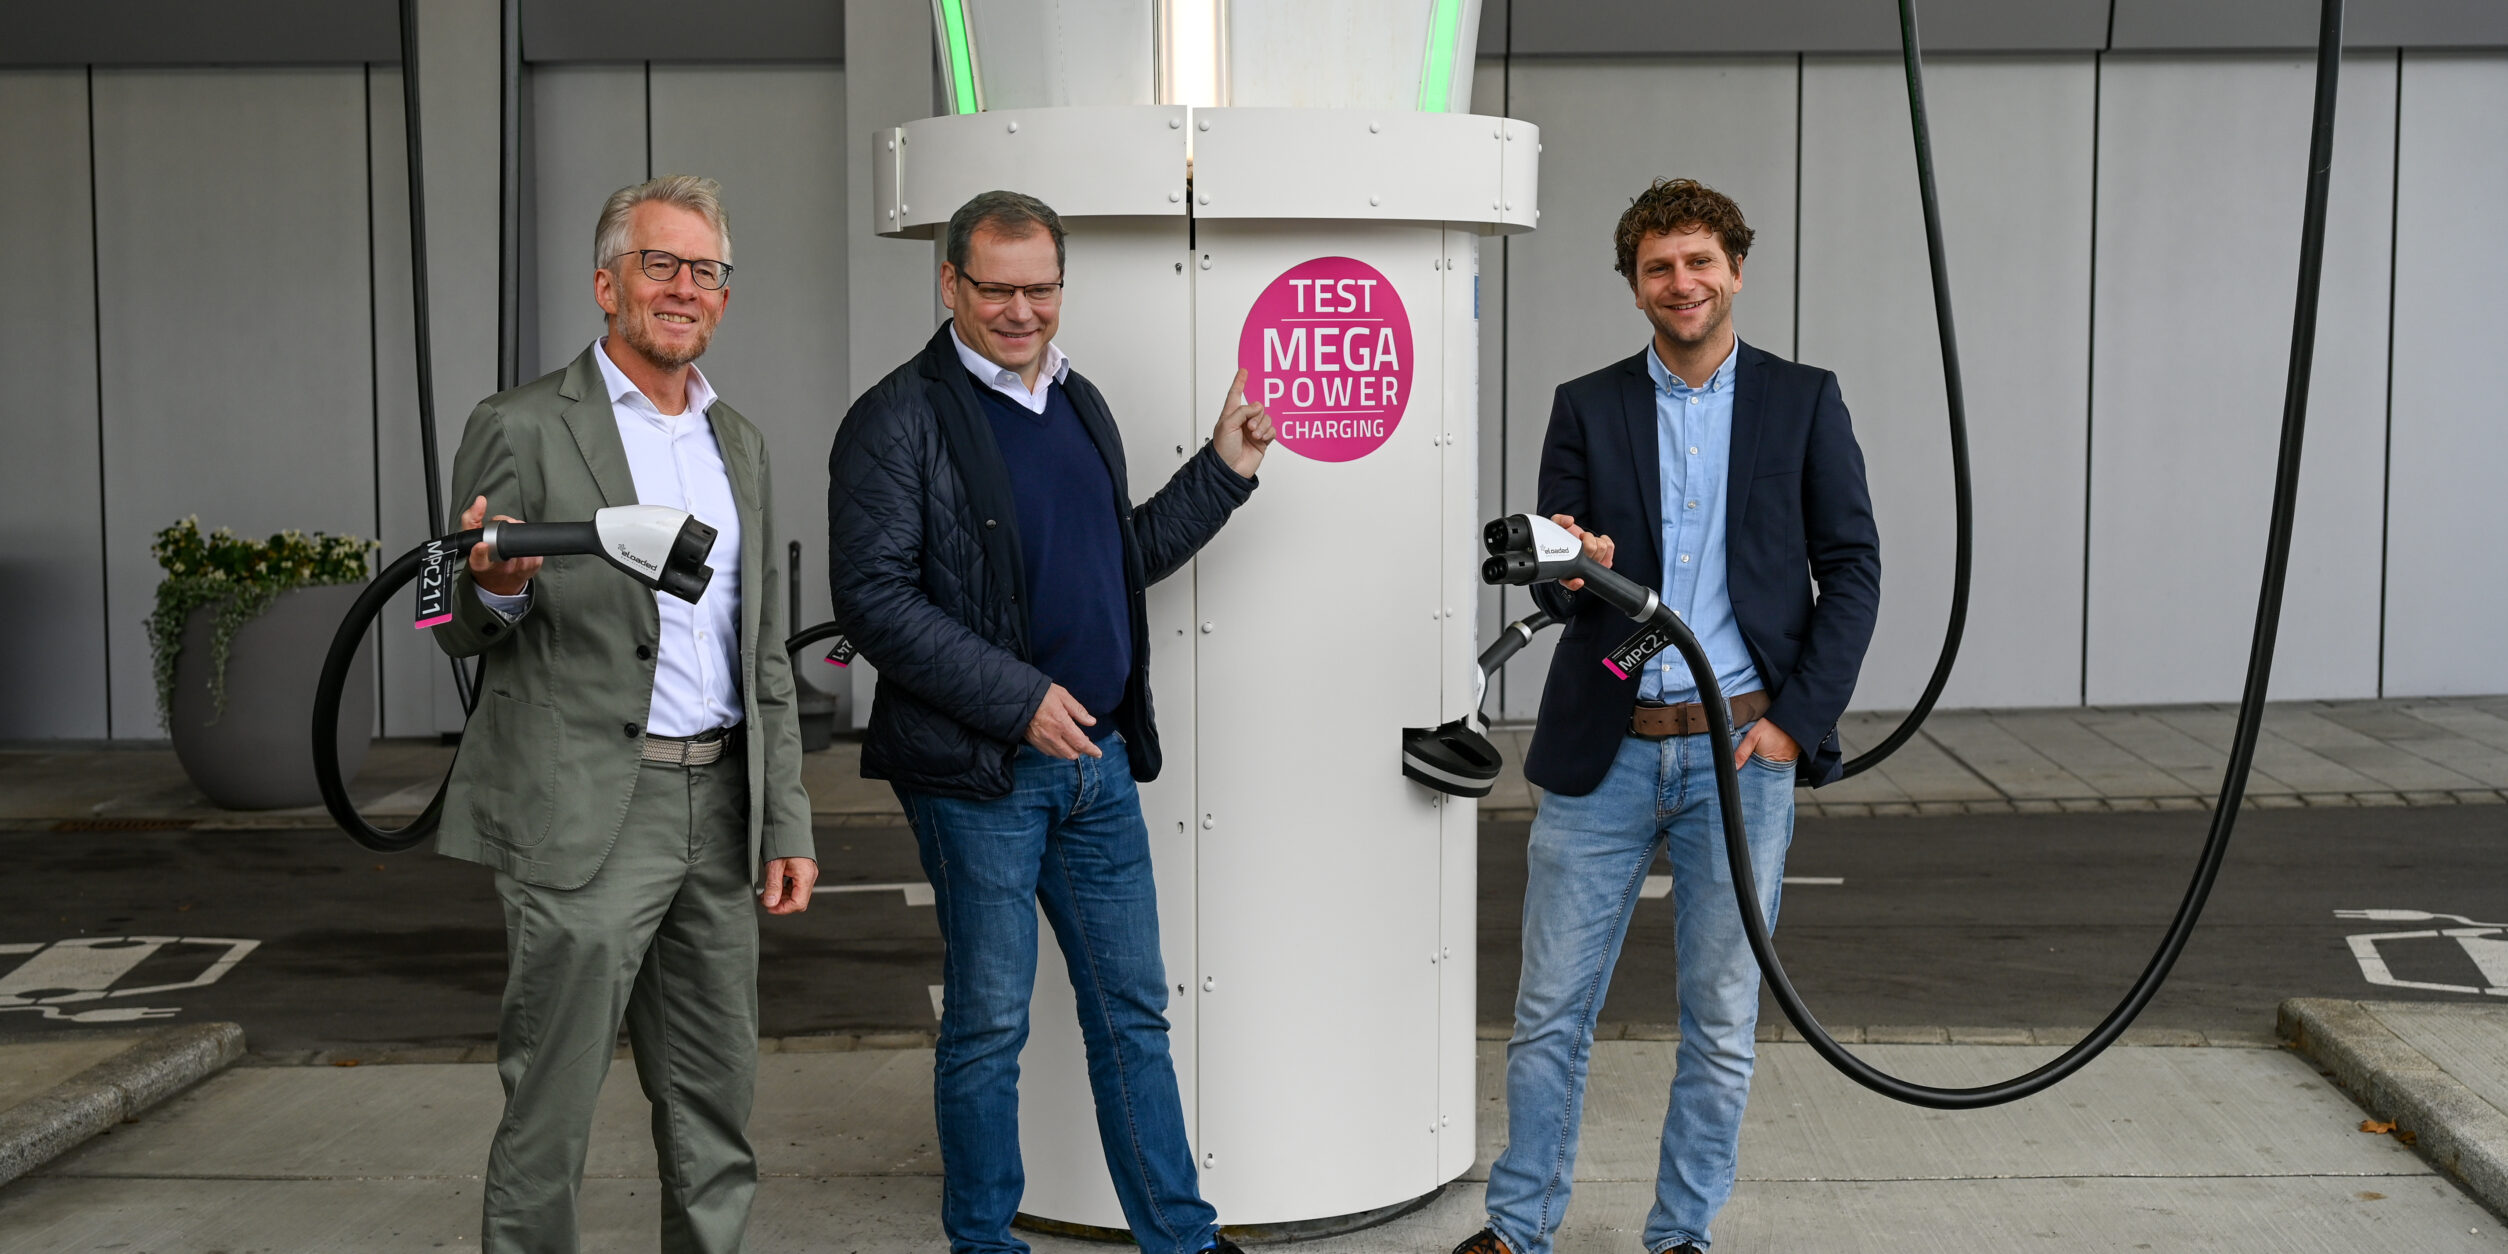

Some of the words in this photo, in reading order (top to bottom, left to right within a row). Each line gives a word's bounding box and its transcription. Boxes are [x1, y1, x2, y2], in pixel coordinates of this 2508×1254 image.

[1288, 279, 1377, 313] TEST
[1263, 327, 1399, 373] MEGA
[1263, 376, 1398, 408] POWER
[1281, 419, 1384, 440] CHARGING
[422, 540, 443, 615] MPC211
